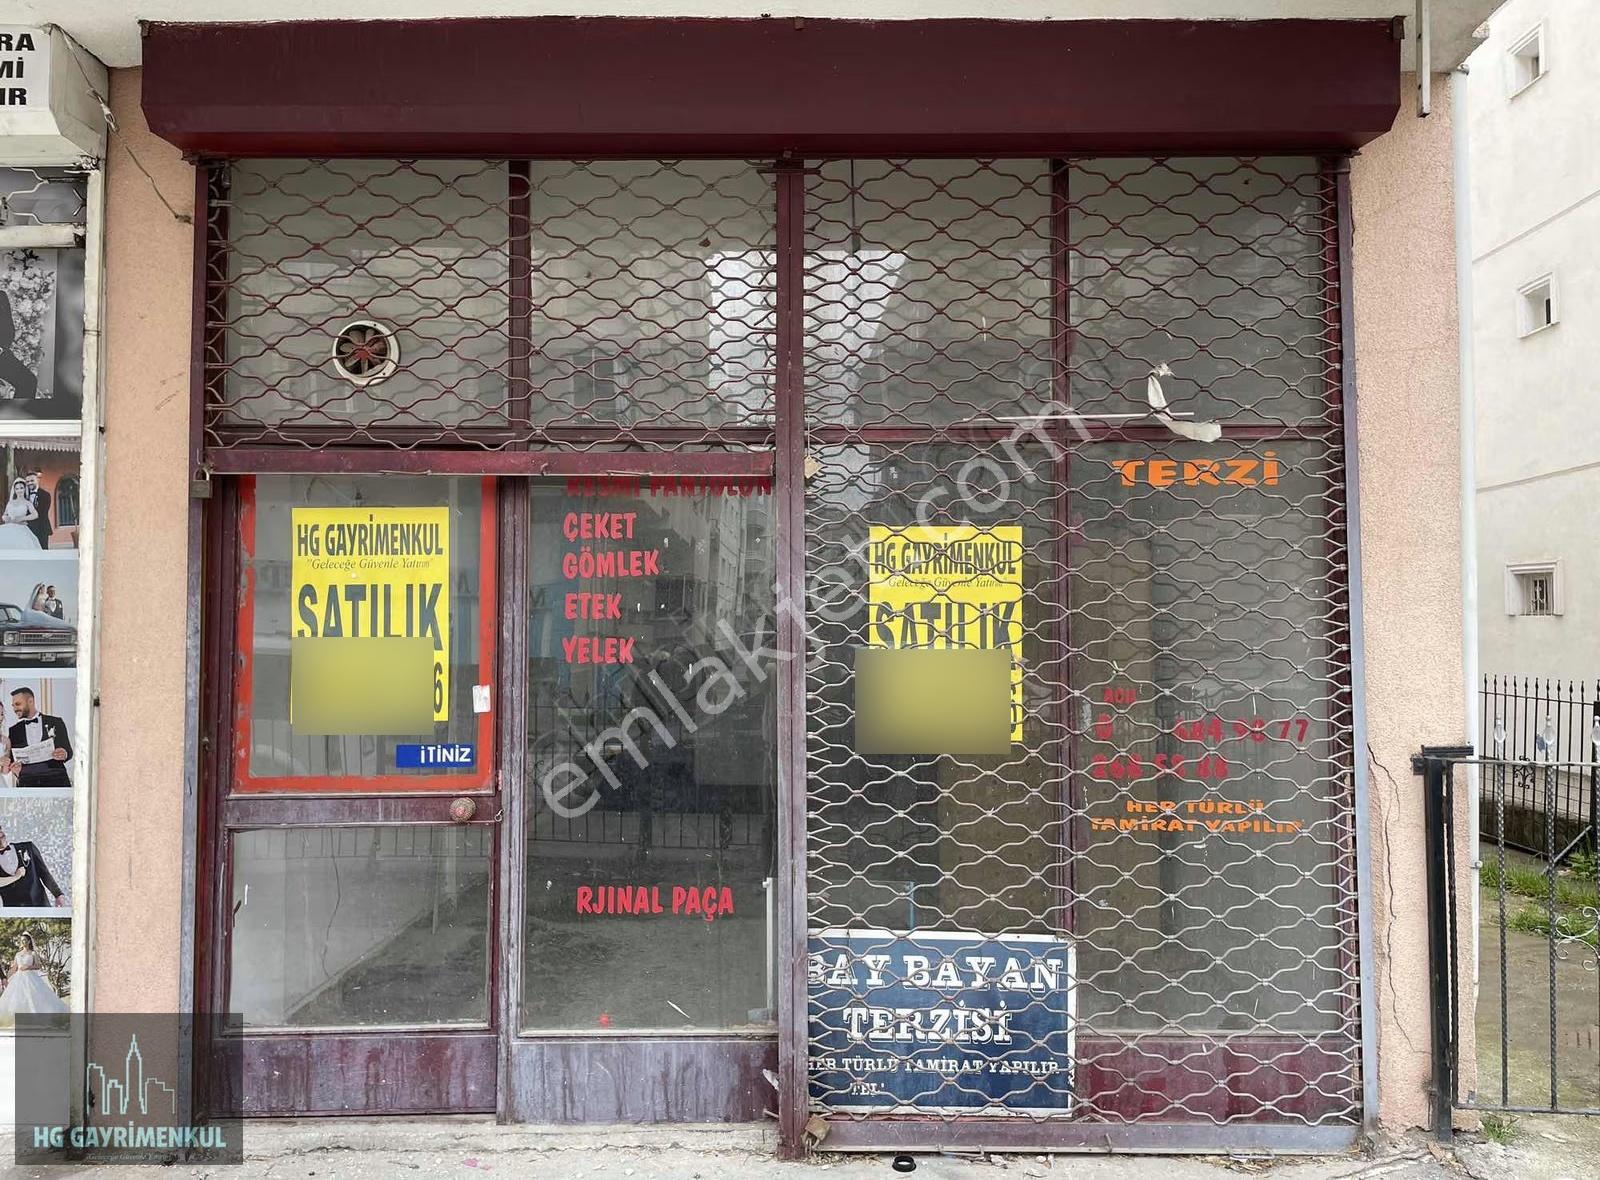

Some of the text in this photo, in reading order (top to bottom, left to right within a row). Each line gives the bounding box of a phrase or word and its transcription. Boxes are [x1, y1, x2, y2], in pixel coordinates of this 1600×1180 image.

[1112, 451, 1279, 487] TERZİ
[297, 514, 443, 556] HG GAYRİMENKUL
[563, 511, 637, 543] ÇEKET
[359, 557, 399, 570] Güvenle
[562, 546, 660, 580] GÖMLEK
[874, 533, 1016, 574] HG GAYRİMENKUL
[297, 583, 443, 650] SATILIK
[564, 592, 623, 620] ETEK
[875, 601, 1017, 655] SATILIK
[562, 634, 636, 664] YELEK
[1278, 719, 1309, 742] 77
[1126, 799, 1265, 815] HER TÜRLÜ
[672, 886, 735, 922] PAÇA
[808, 954, 1063, 993] BAY BAYAN
[842, 1000, 1013, 1044] TERZİSİ
[841, 1055, 899, 1073] TÜRLÜ
[904, 1056, 983, 1075] TAMİRAT
